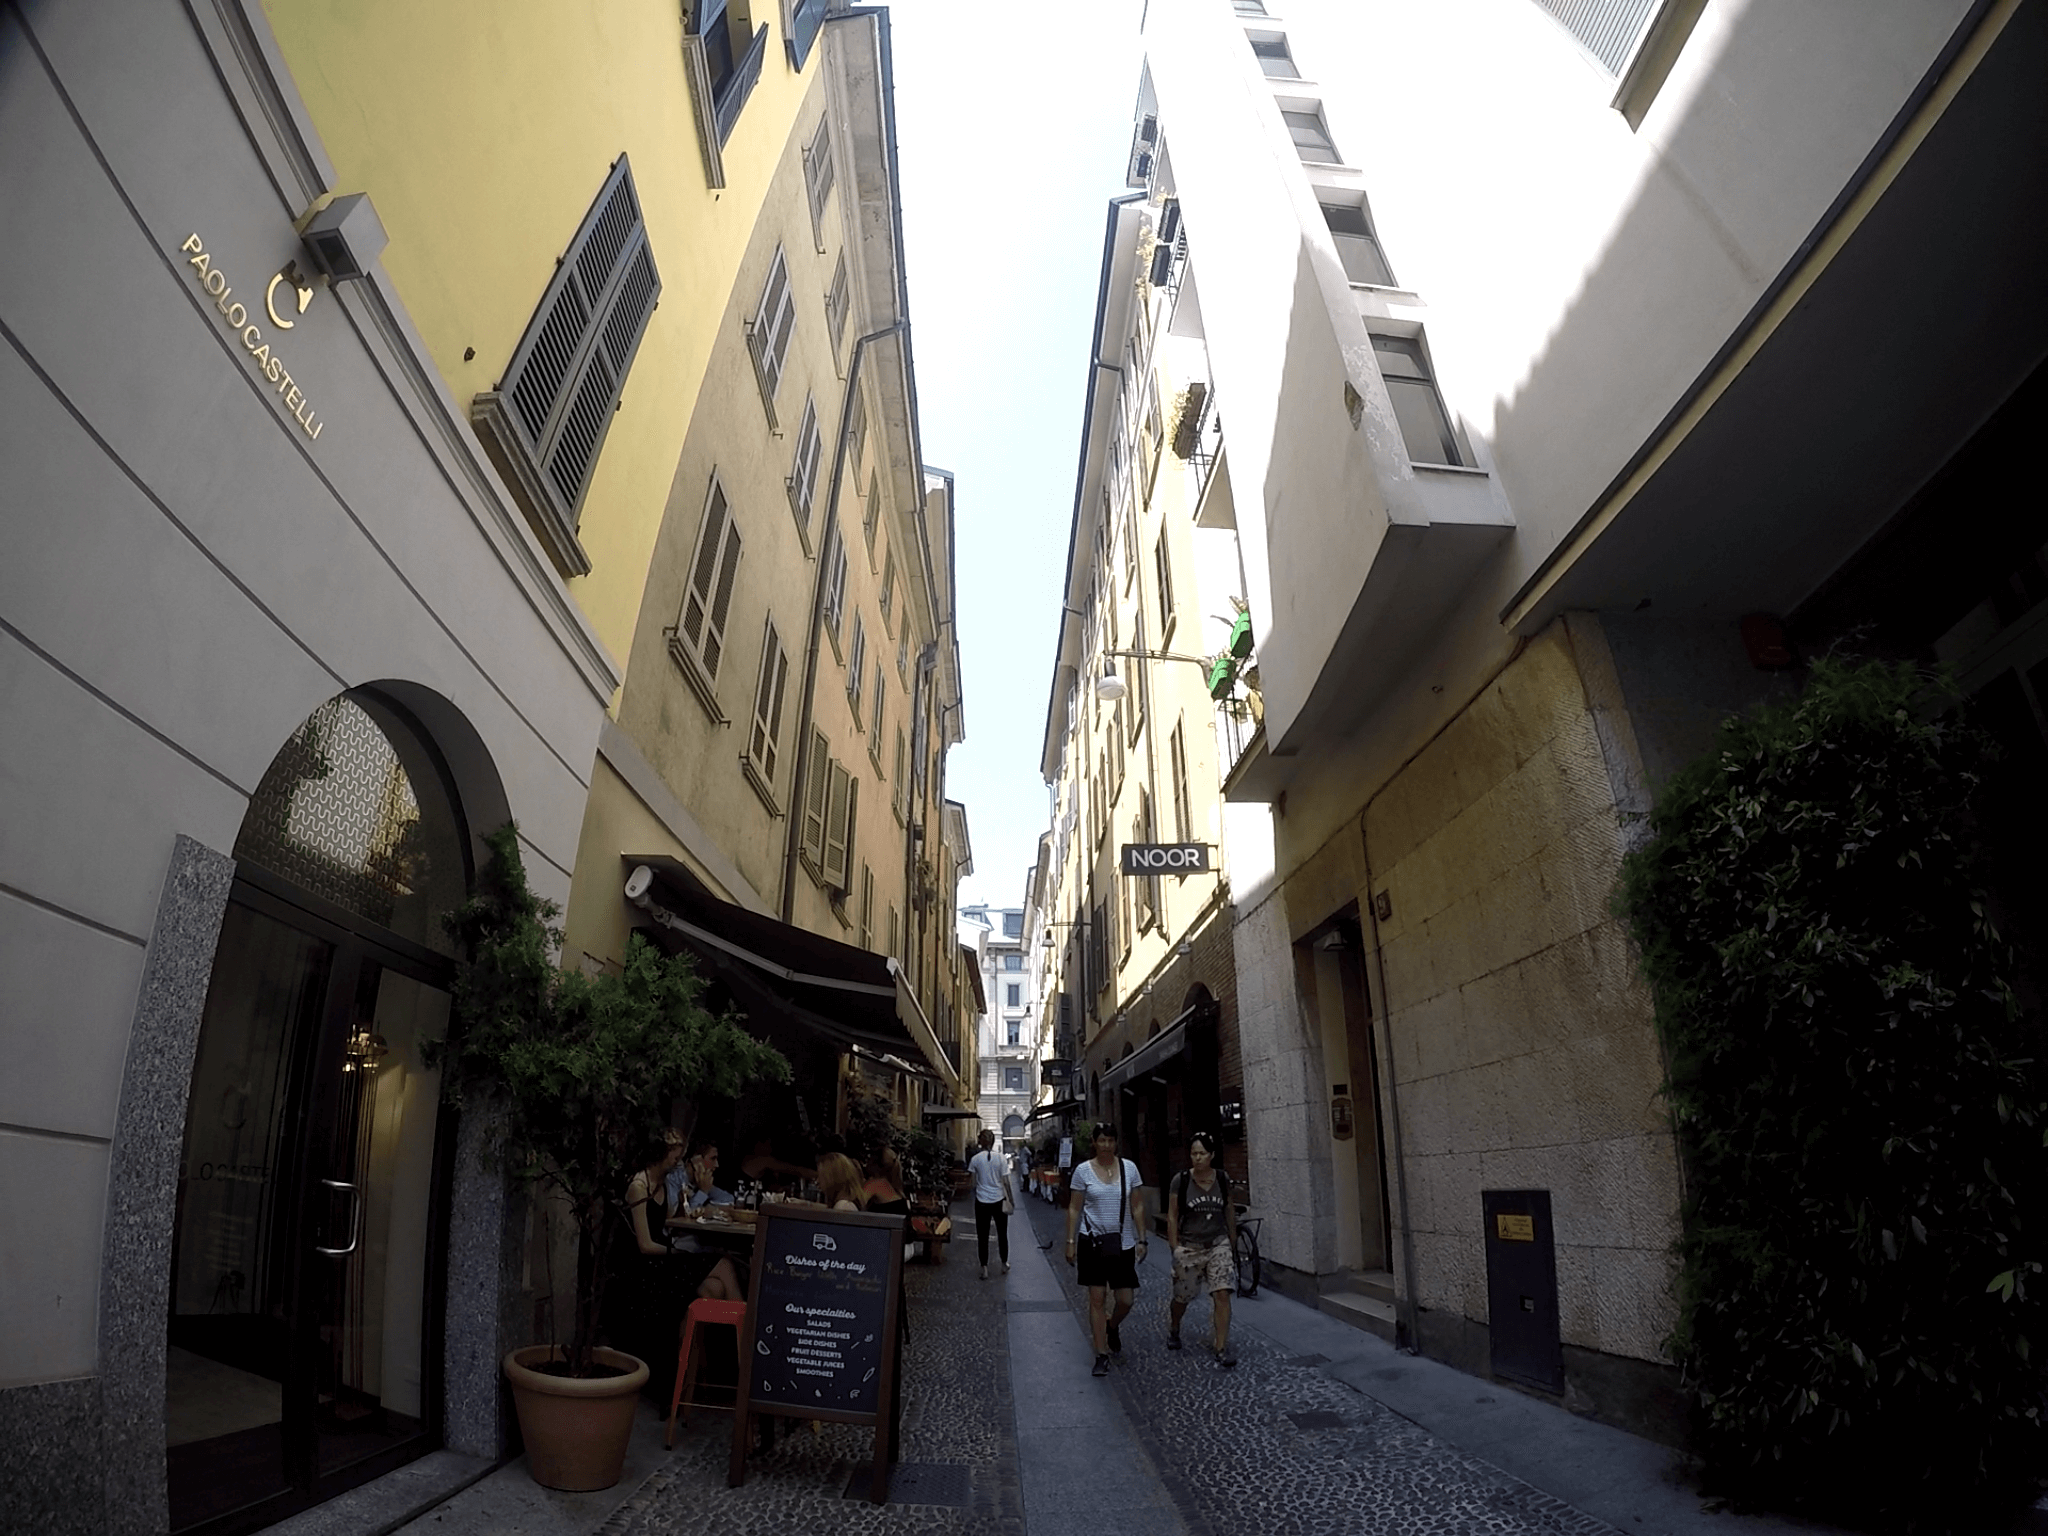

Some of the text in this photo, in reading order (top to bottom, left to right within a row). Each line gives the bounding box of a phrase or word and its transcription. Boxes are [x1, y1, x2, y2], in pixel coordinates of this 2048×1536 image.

[181, 232, 324, 440] PAOLO CASTELLI
[1131, 848, 1201, 868] NOOR
[1187, 1195, 1211, 1208] MIAMI
[785, 1254, 867, 1274] Dishes of the day
[785, 1303, 857, 1319] Our specialties
[806, 1319, 831, 1328] SALADS
[786, 1326, 851, 1340] VEGETARIAN DISHES
[797, 1338, 837, 1349] SIDE DISHES
[791, 1347, 842, 1359] FRUIT DESSERTS
[786, 1356, 845, 1369] VEGETABLE JUICES
[796, 1367, 834, 1378] SMOOTHIES
